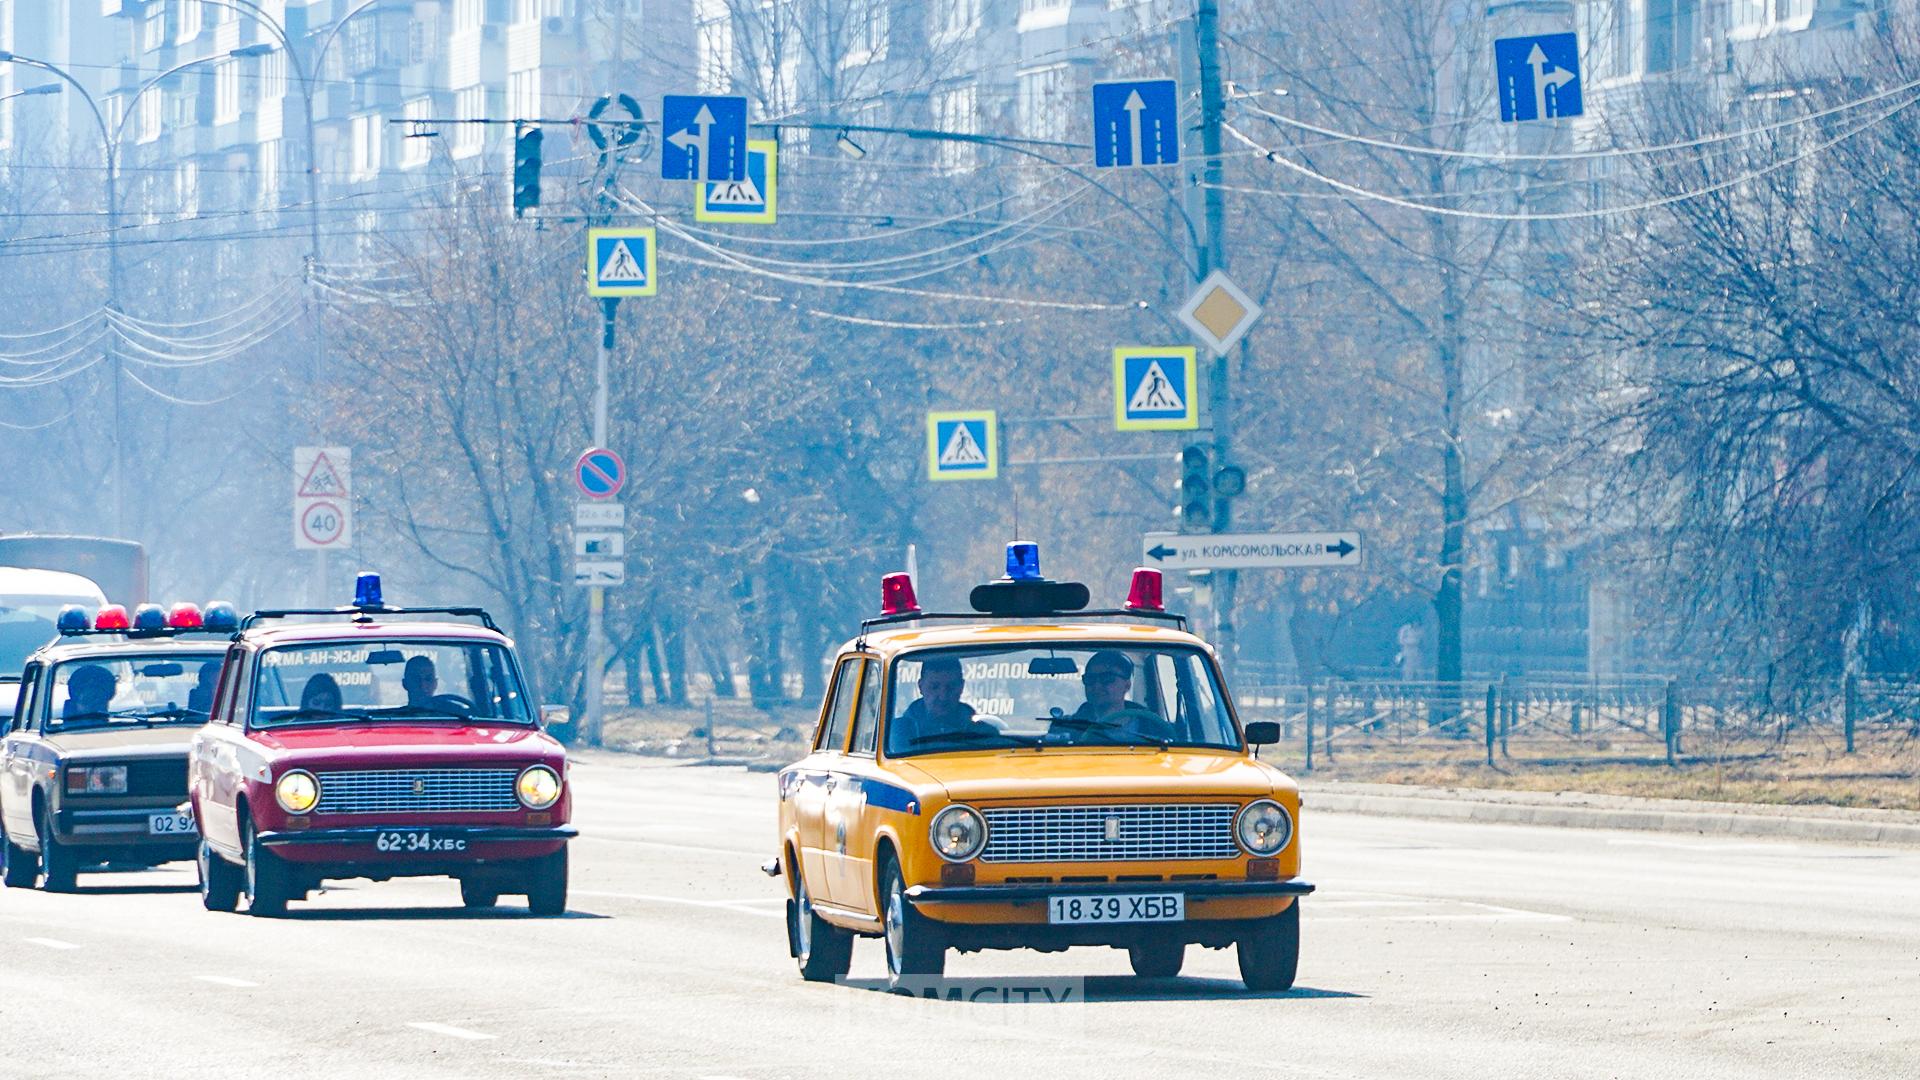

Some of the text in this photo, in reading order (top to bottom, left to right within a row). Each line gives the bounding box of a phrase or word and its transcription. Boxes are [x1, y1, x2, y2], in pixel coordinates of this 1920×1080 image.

[312, 514, 336, 532] 40
[1202, 543, 1324, 558] КОМСОМОЛЬСКАЯ
[1128, 896, 1178, 919] ХБВ
